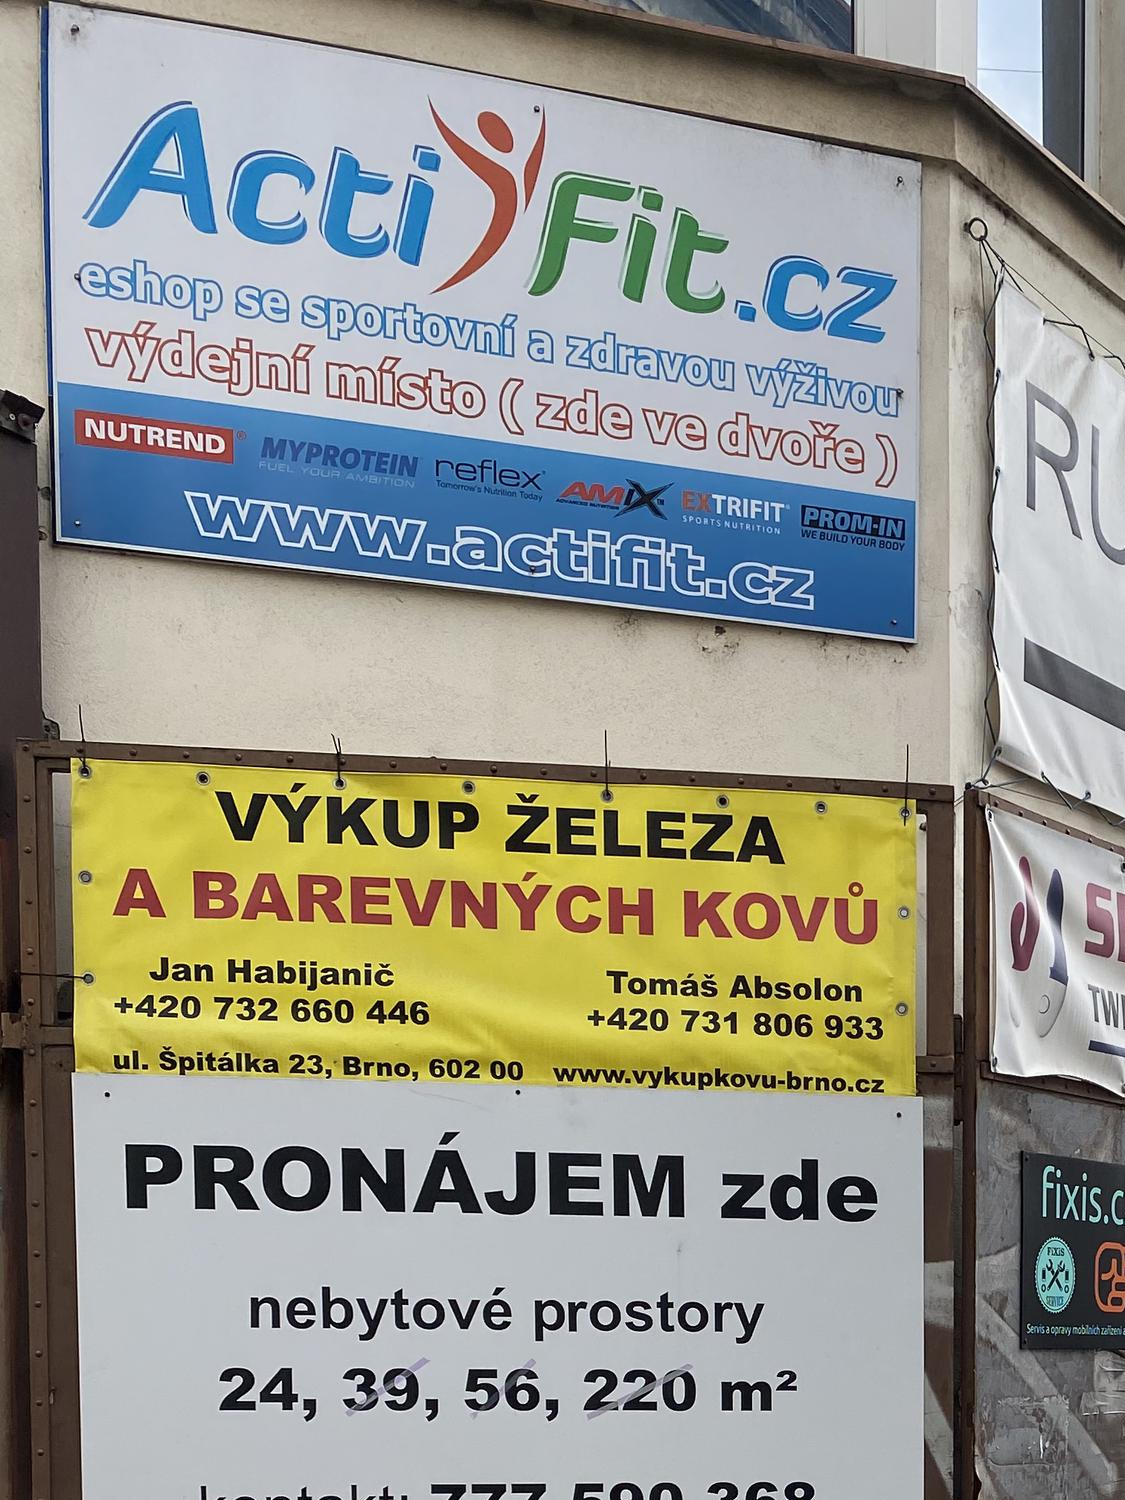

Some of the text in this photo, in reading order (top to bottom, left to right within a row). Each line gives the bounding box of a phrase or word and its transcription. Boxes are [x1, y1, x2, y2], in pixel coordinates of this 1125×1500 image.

[79, 259, 900, 418] eshop se sportovní a zdravou výživou
[84, 320, 316, 397] výdejní
[326, 356, 487, 419] místo
[536, 389, 633, 440] zde
[642, 407, 708, 451] ve
[718, 412, 865, 474] dvoře
[84, 418, 226, 456] NUTREND
[261, 436, 419, 478] MYPROTEIN
[258, 461, 416, 489] FUEL YOUR AMBITION
[435, 459, 542, 490] reflex
[436, 479, 543, 502] Tomorrow's Nutrition Today
[682, 490, 785, 523] EXTRIFIT
[682, 514, 781, 535] SPORTS NUTRITION
[801, 530, 905, 551] WE BUILD YOUR BODY
[184, 490, 815, 610] www.actifit.cz
[214, 783, 786, 865] VÝKUP ŽELEZA
[112, 868, 879, 945] A BAREVNÝCH KOVŮ
[149, 956, 396, 990] Jan Habijanič
[606, 970, 863, 1003] Tomáš Absolon
[113, 994, 431, 1025] +420 732 660 446
[587, 1007, 884, 1041] +420 731 806 933
[113, 1046, 524, 1081] ul. Špitálka 23, Brno, 602 00
[553, 1066, 885, 1093] www.vykupkovu-brno.cz
[123, 1131, 879, 1223] PRONÁJEM zde
[248, 1285, 766, 1344] nebytové prostory
[1026, 1323, 1045, 1334] Servis
[1045, 1326, 1050, 1334] a
[1051, 1326, 1071, 1337] opravy
[1072, 1324, 1100, 1335] mobilních
[218, 1367, 318, 1421] 24,
[342, 1367, 438, 1421] 39,
[463, 1367, 559, 1421] 56,
[583, 1367, 697, 1413] 220
